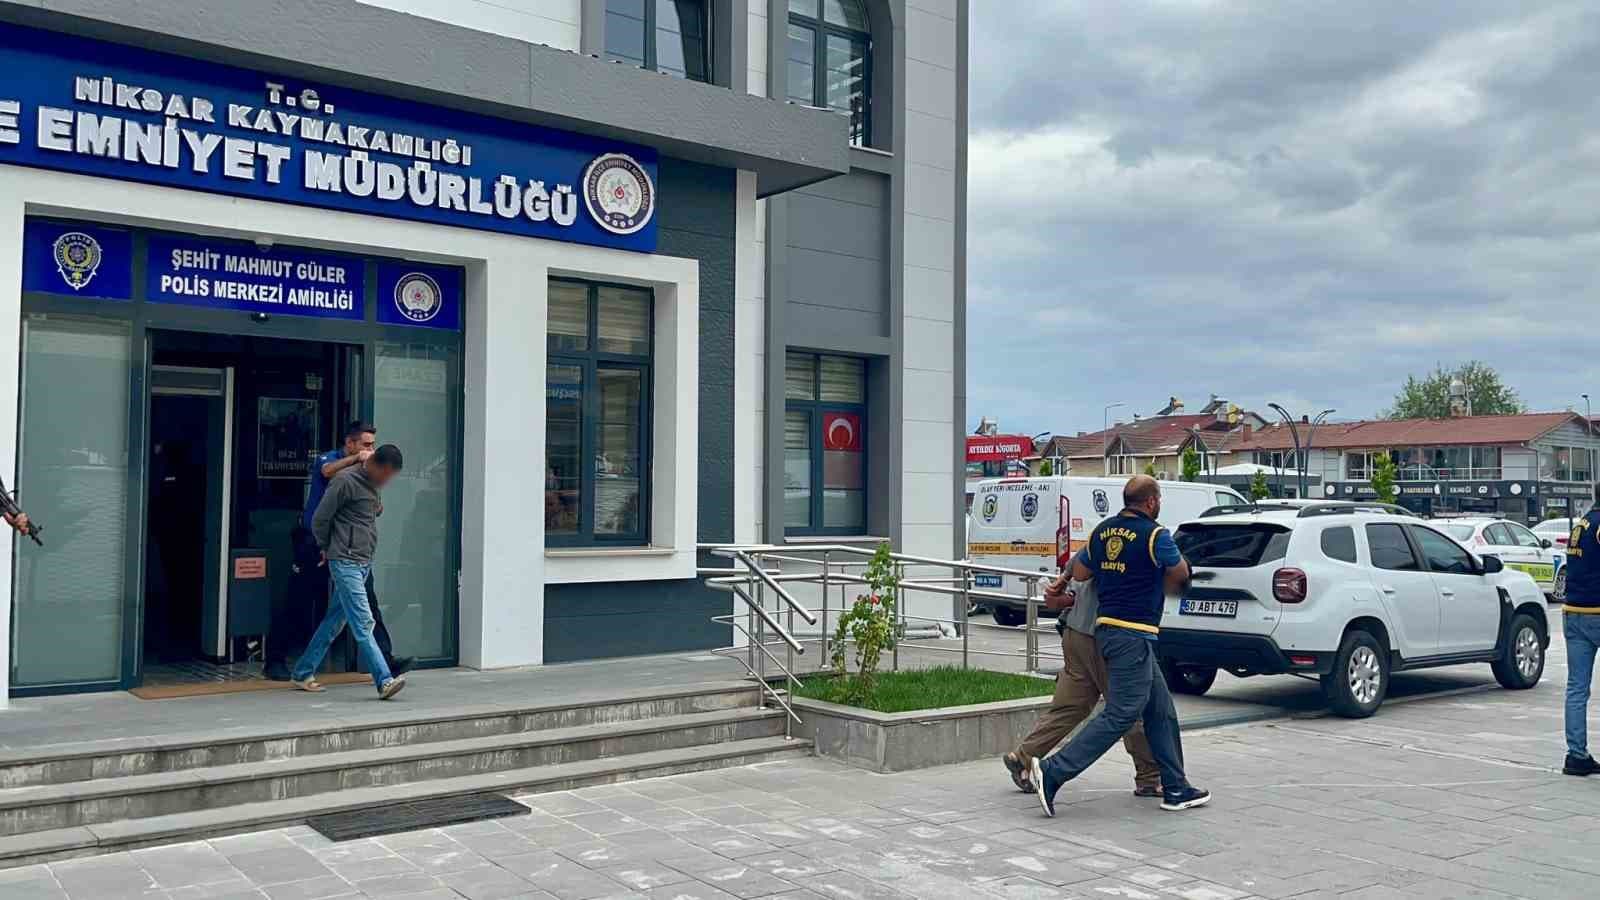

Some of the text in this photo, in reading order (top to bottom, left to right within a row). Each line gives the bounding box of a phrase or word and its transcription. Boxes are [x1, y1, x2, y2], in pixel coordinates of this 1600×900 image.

[265, 82, 335, 114] T.C.
[75, 76, 472, 167] NİKSAR KAYMAKAMLIĞI
[37, 105, 291, 184] EMNİYET
[304, 149, 578, 226] MÜDÜRLÜĞÜ
[171, 249, 346, 284] ŞEHİT MAHMUT GÜLER
[161, 275, 354, 310] POLİS MERKEZİ AMİRLİĞİ
[1198, 601, 1216, 613] ABT
[1218, 602, 1235, 614] 476
